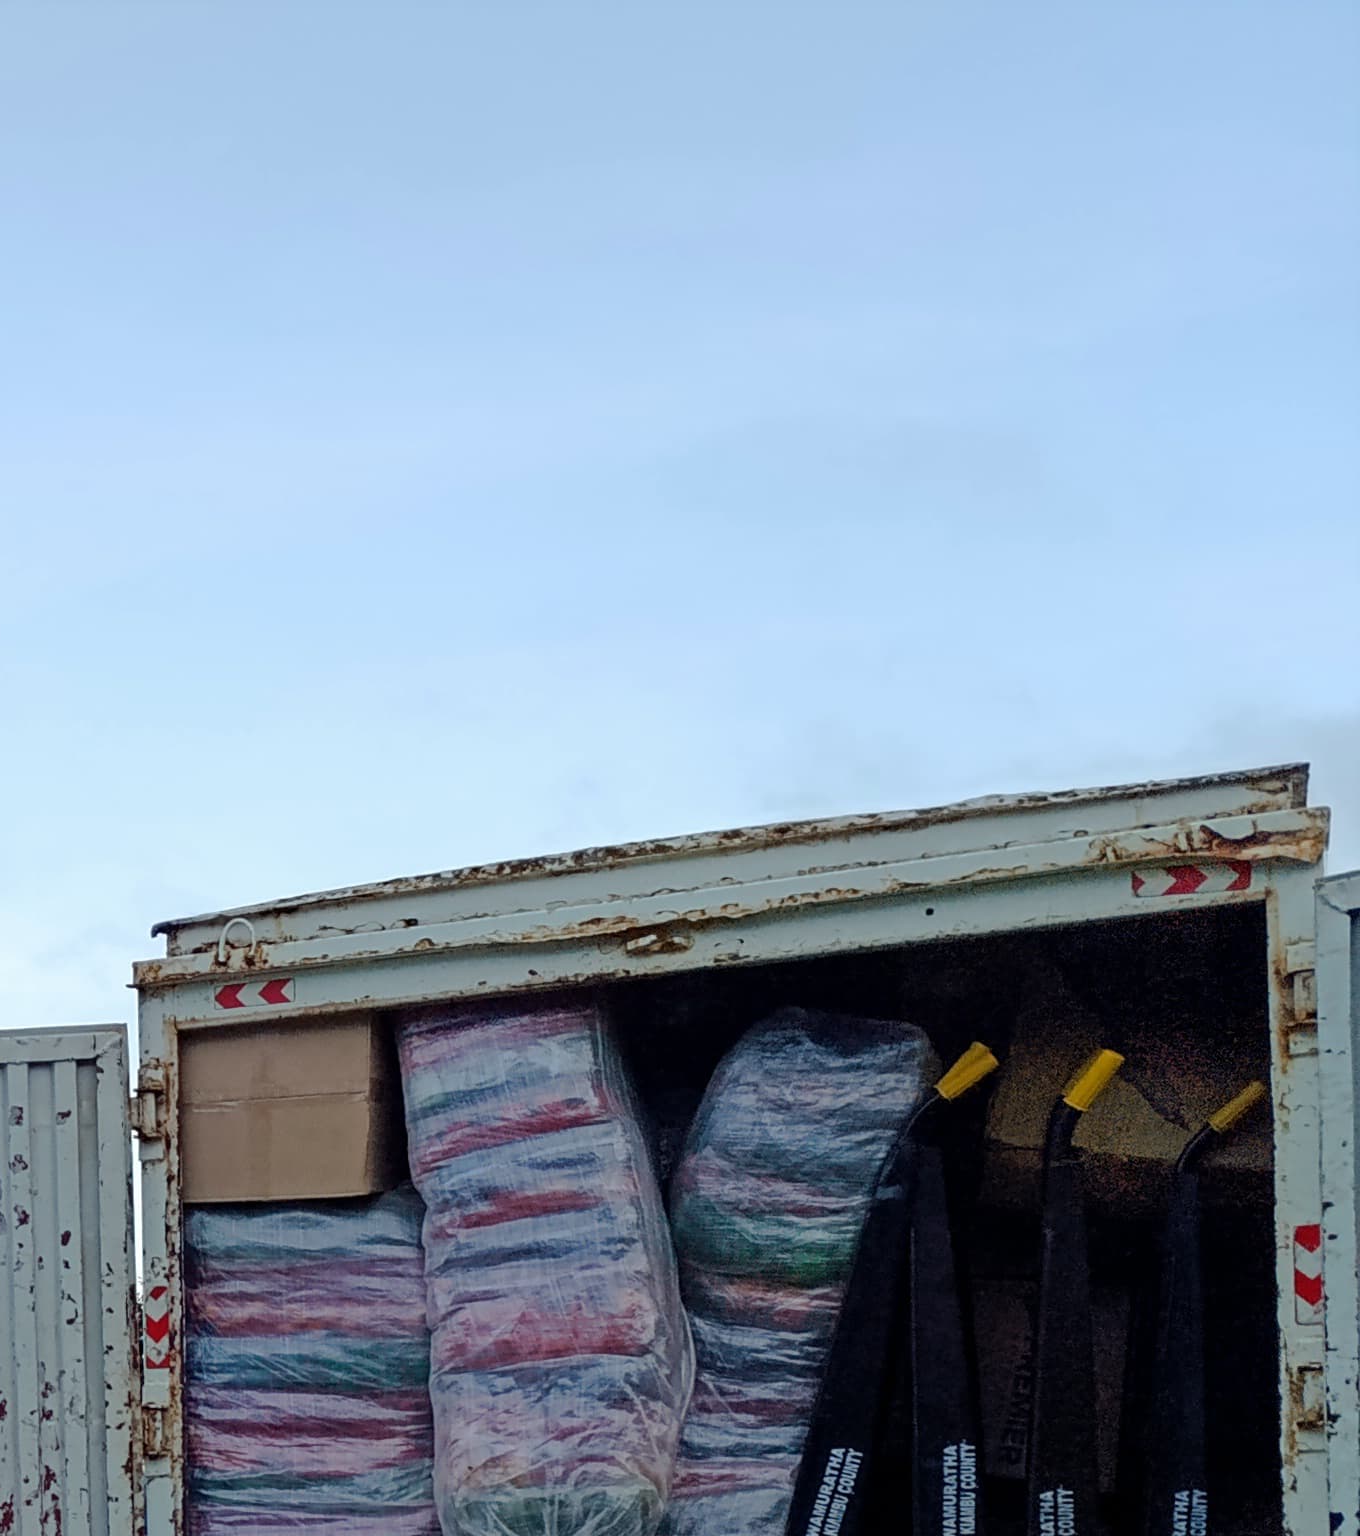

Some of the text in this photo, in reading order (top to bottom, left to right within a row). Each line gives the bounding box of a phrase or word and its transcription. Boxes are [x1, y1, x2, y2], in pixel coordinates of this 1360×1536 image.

[836, 1447, 864, 1495] COUNTY
[959, 1442, 977, 1490] COUNTY
[959, 1491, 977, 1535] KIAMBU
[1056, 1488, 1076, 1536] COUNTY
[1189, 1489, 1208, 1536] COUNTY
